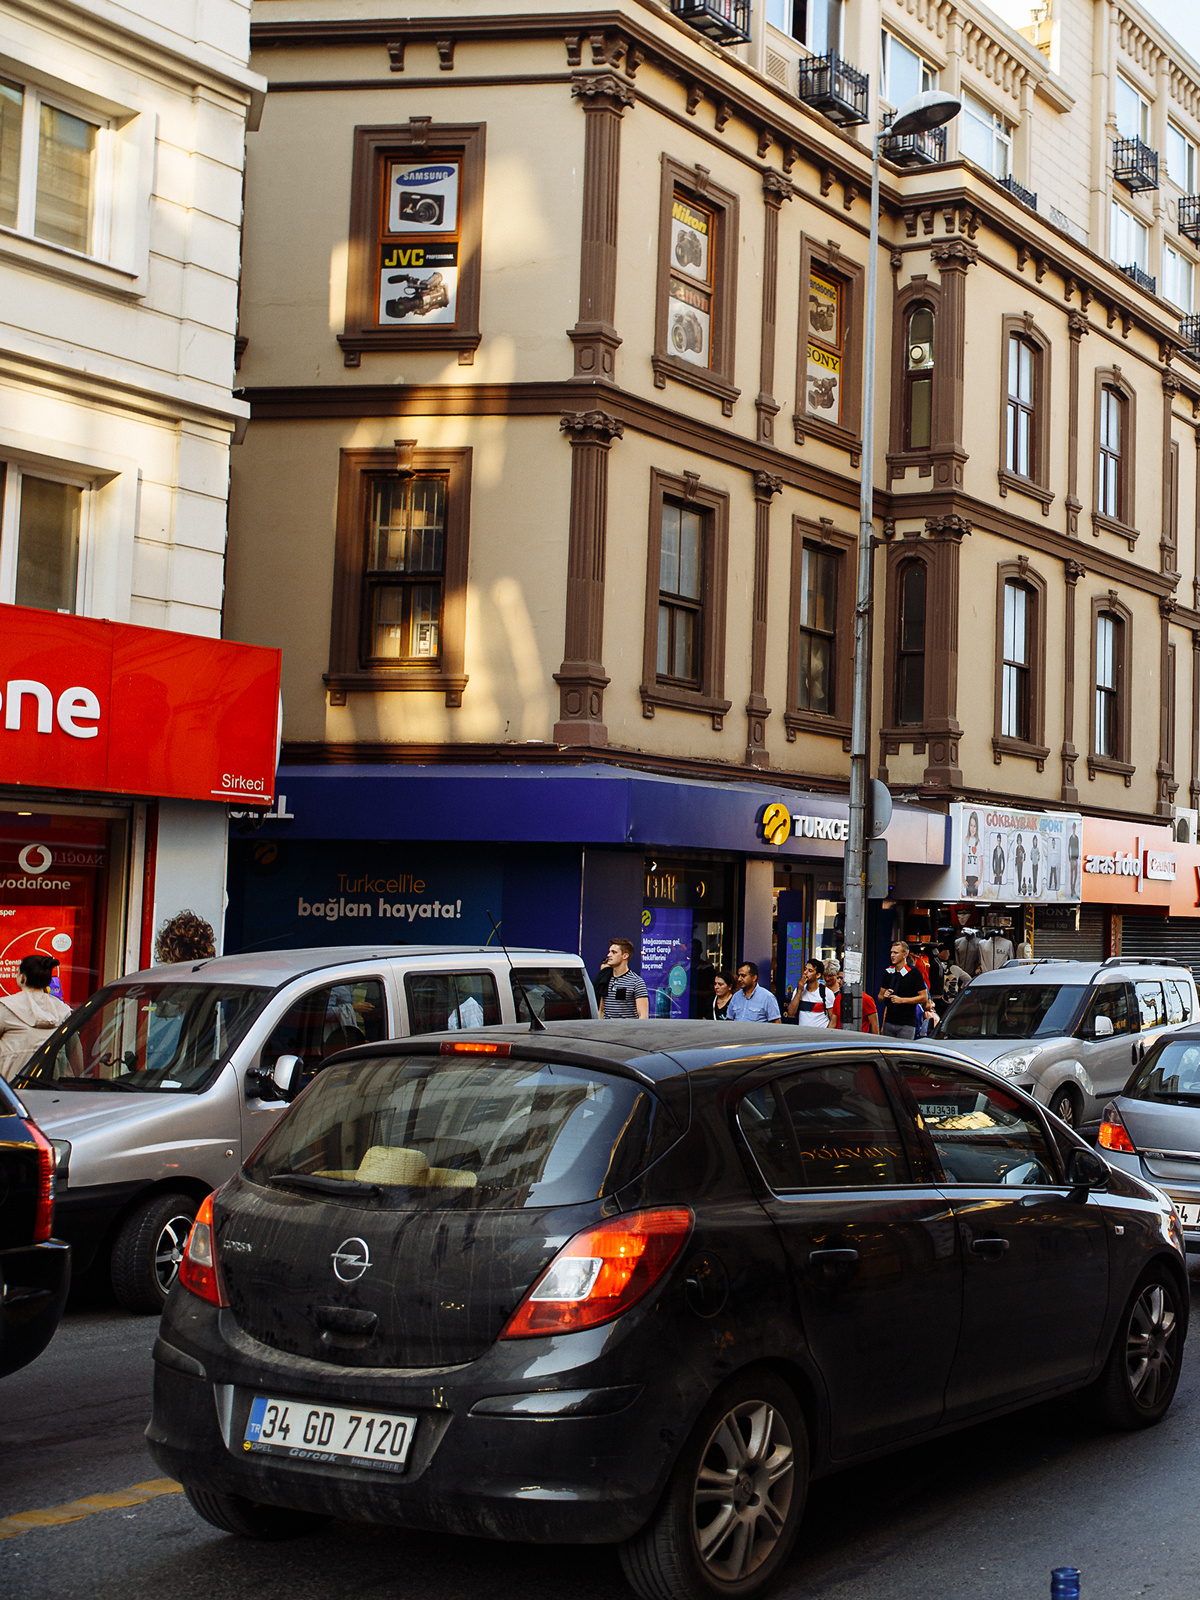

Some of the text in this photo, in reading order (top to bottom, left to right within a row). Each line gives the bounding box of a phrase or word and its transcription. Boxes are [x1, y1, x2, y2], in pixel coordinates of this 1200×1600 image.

[403, 170, 448, 181] SAMSUNG
[672, 201, 708, 234] Nikon
[384, 249, 424, 266] JVC
[669, 280, 709, 312] Canon
[810, 280, 837, 300] anasonic
[807, 347, 839, 370] SONY
[0, 679, 101, 739] ne
[222, 774, 264, 791] Sirkeci
[792, 814, 849, 841] TURKCE
[986, 811, 1063, 833] GÖKBAYRAK SPORT
[967, 855, 978, 865] NY
[1085, 851, 1140, 876] aras foto
[0, 876, 72, 890] vodafone
[337, 873, 426, 894] Turkcell'le
[298, 897, 462, 923] bağlan hayata!
[1037, 907, 1073, 916] SONY
[1056, 921, 1068, 929] foto
[250, 1405, 408, 1457] TR 34 GD 7120
[251, 1443, 273, 1453] OPEL
